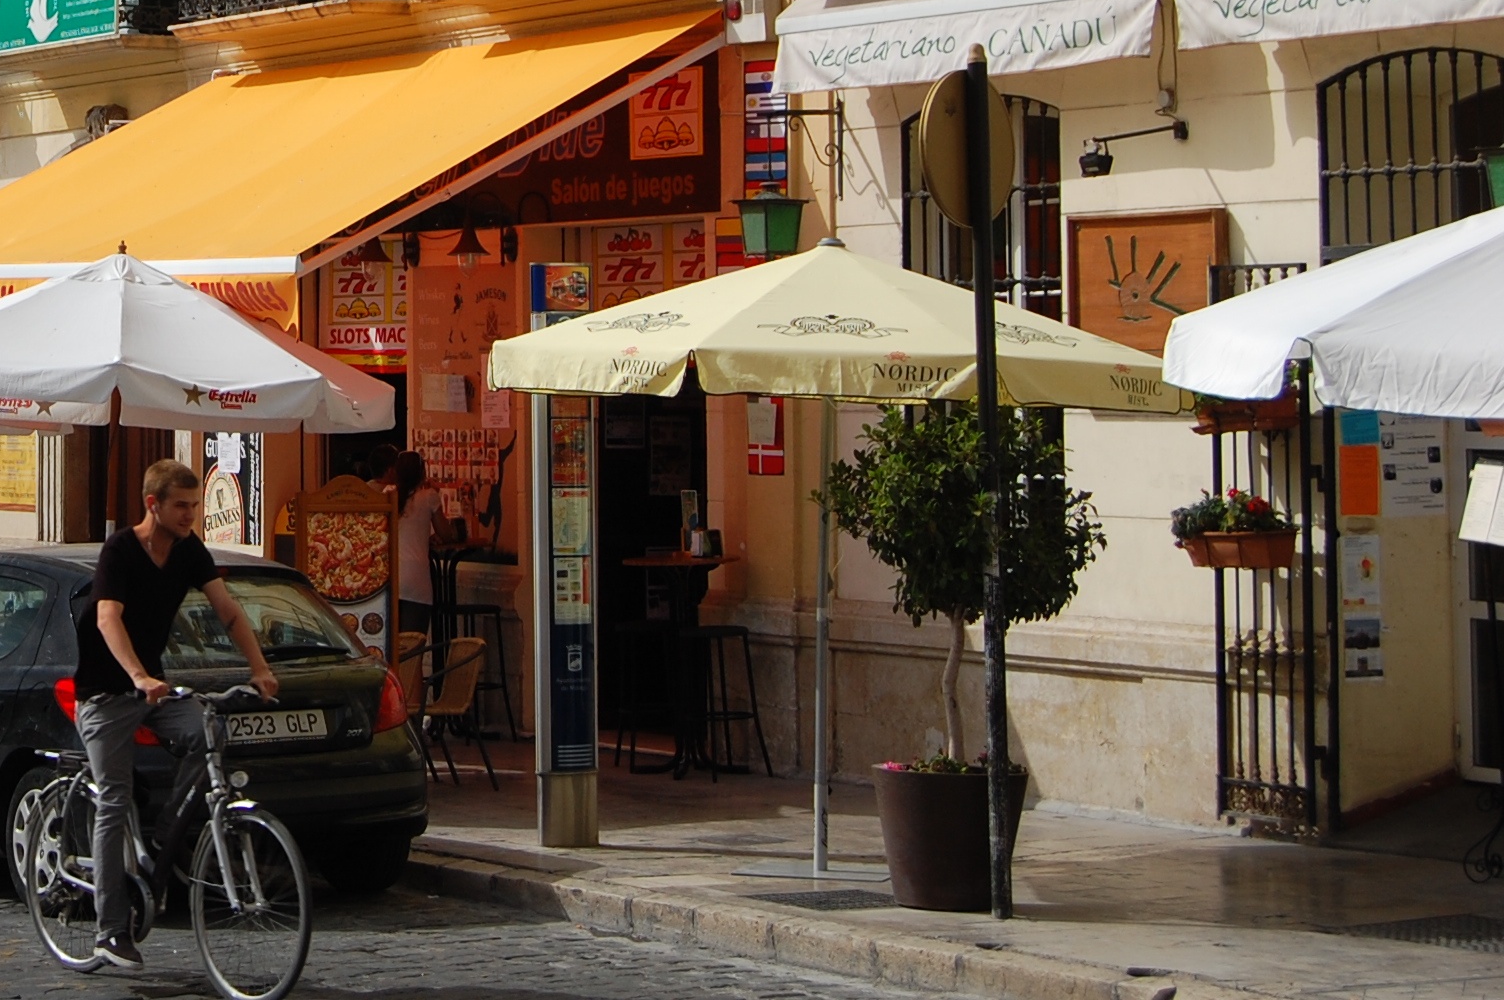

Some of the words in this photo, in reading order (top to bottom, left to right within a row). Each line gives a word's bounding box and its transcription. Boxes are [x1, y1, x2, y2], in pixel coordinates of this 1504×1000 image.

[988, 4, 1117, 58] CAÑADÚ
[551, 174, 600, 206] Salón
[605, 172, 627, 200] de
[631, 171, 695, 206] juegos
[475, 287, 507, 304] JAMESON
[330, 328, 371, 345] SLOTS
[208, 388, 257, 404] Estrella
[204, 506, 241, 531] GUINNESS
[230, 714, 277, 737] 2523
[285, 712, 318, 734] GLP
